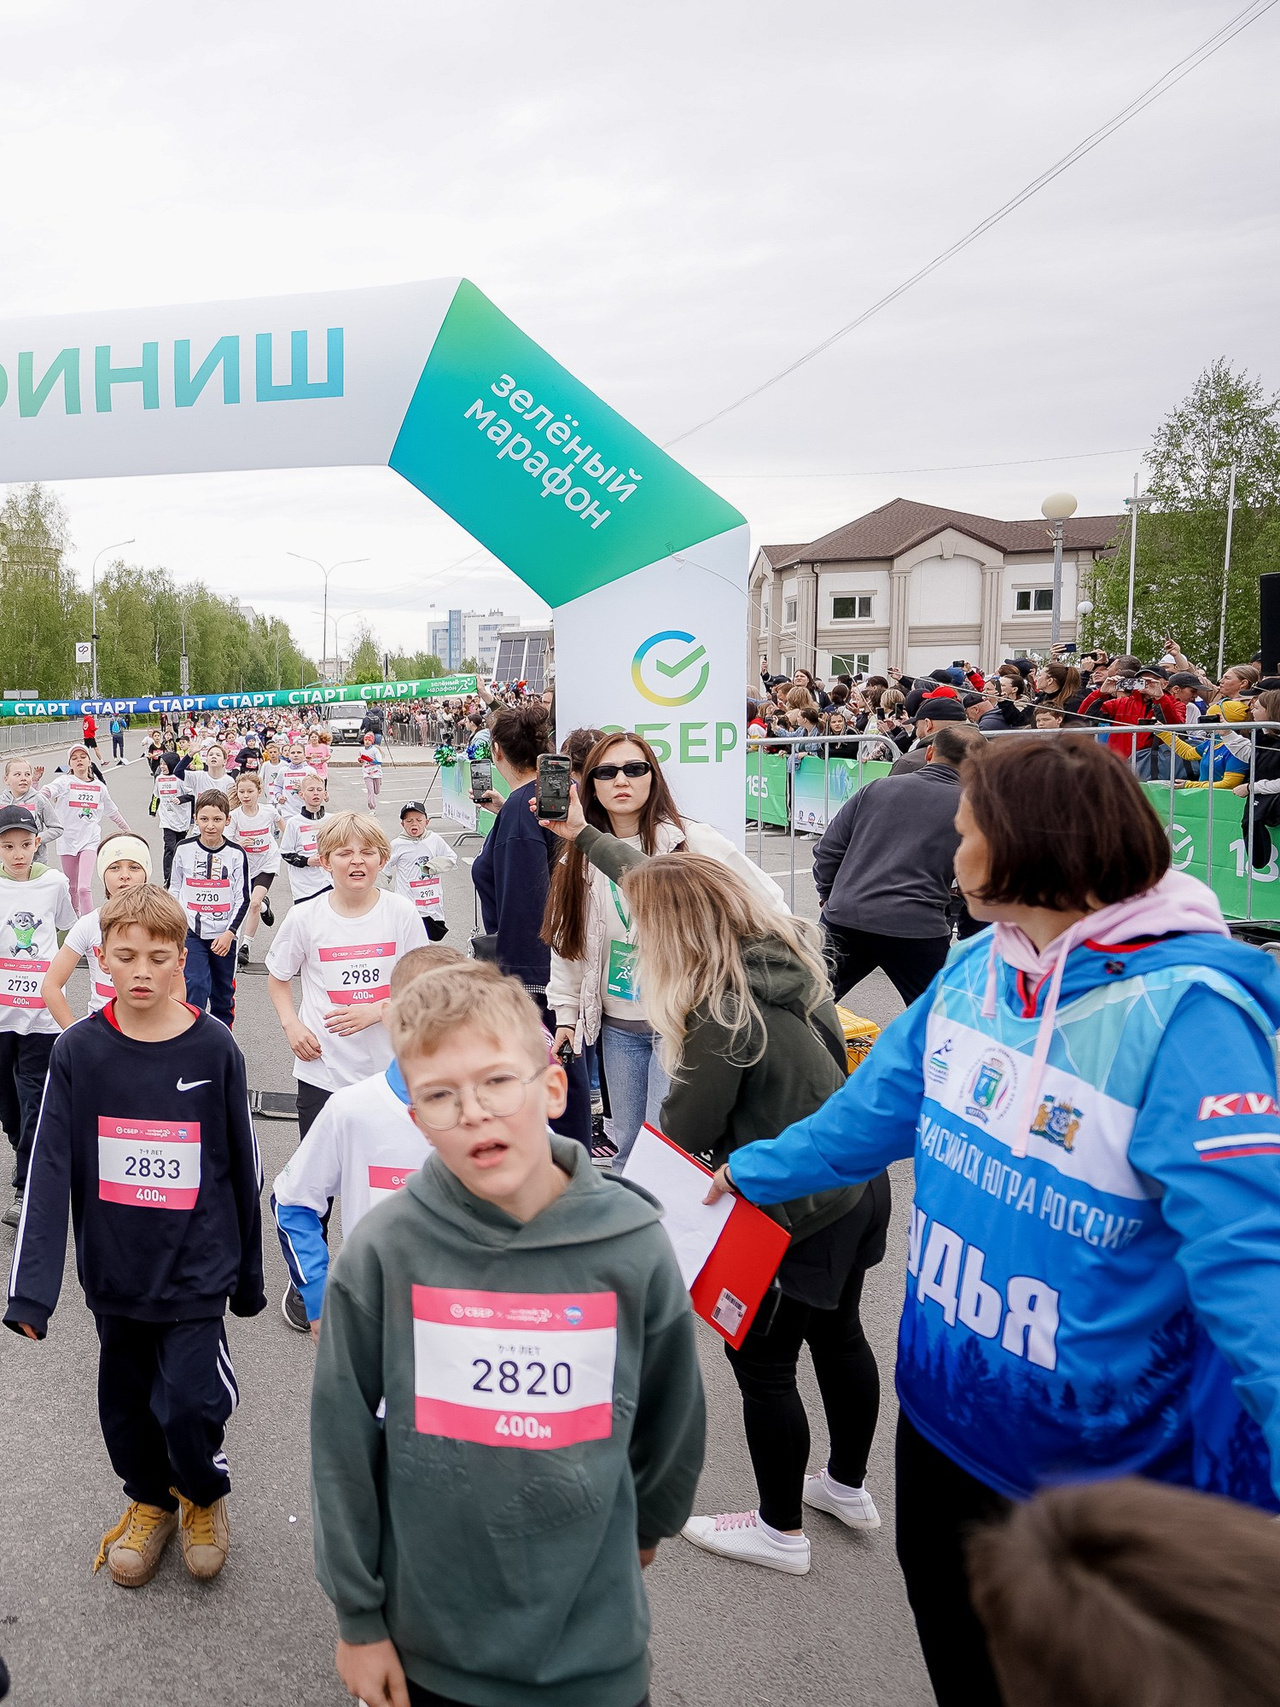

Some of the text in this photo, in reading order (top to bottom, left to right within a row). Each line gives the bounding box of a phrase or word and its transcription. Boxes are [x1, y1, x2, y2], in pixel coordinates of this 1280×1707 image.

[491, 373, 643, 504] зелёный
[463, 398, 612, 530] марафон
[14, 702, 70, 716] СТАРТ
[80, 700, 138, 715] СТАРТ
[148, 697, 206, 713] СТАРТ
[217, 694, 277, 710] СТАРТ
[287, 687, 348, 706] СТАРТ
[359, 682, 421, 701] СТАРТ
[602, 722, 739, 765] БЕР
[77, 793, 94, 802] 2722
[747, 774, 769, 799] 185
[195, 893, 219, 902] 2730
[7, 978, 38, 993] 2739
[341, 968, 380, 985] 2988
[1198, 1092, 1280, 1121] KV
[124, 1156, 181, 1179] 2833
[980, 1155, 1037, 1215] ЮГРА
[1039, 1184, 1144, 1250] РОССИЯ
[471, 1358, 572, 1396] 2820
